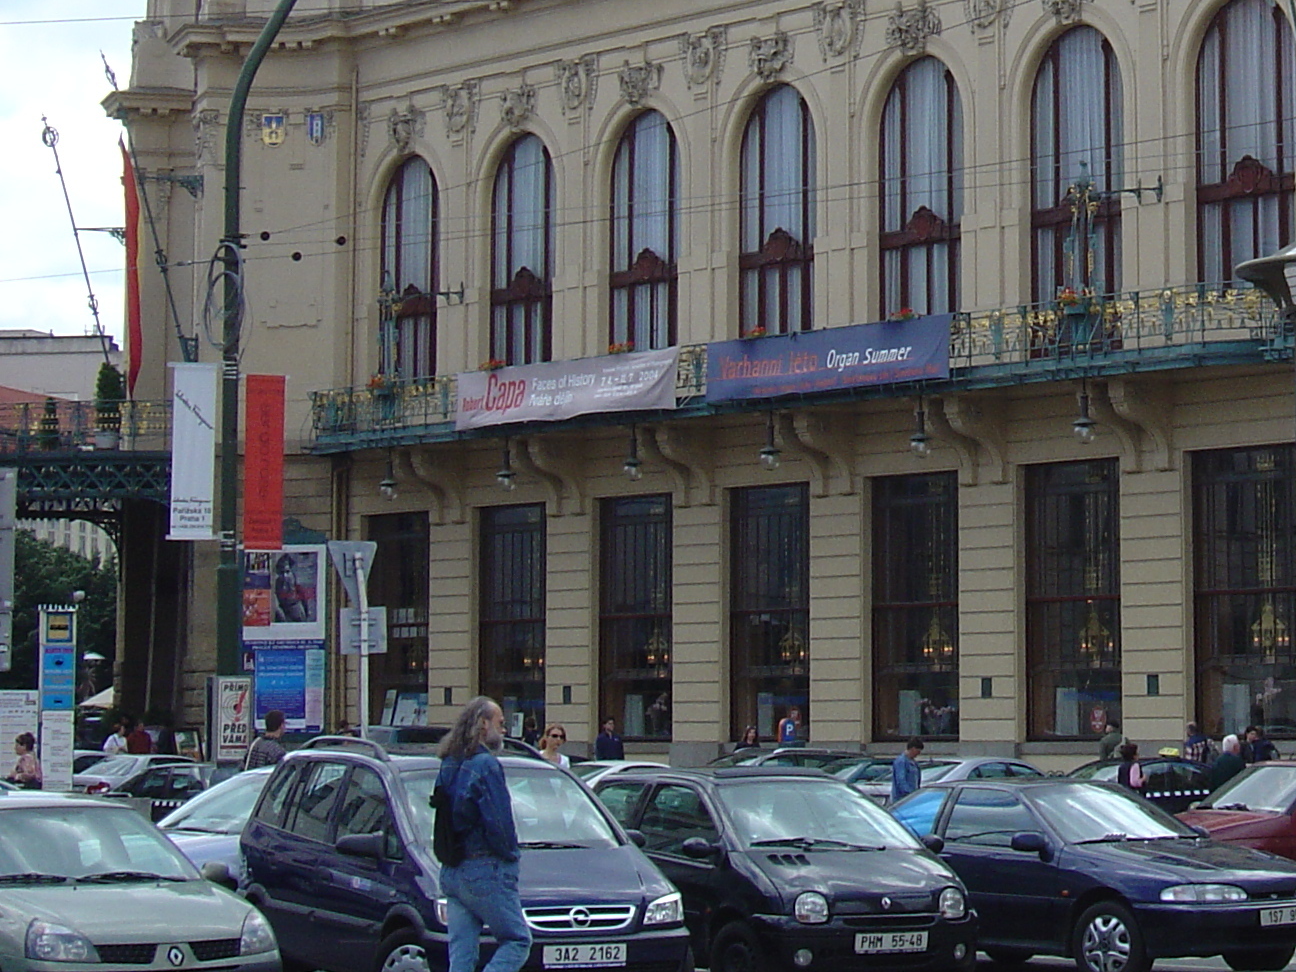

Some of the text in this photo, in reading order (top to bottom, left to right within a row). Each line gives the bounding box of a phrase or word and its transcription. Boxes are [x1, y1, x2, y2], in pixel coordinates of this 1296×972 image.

[826, 345, 912, 372] Organ Summer
[531, 373, 596, 391] Faces of History
[485, 373, 526, 415] Capa
[786, 723, 794, 736] P
[1269, 909, 1284, 924] 1S7
[861, 934, 923, 948] PHM 55-48
[555, 946, 620, 962] 3A2 2162
